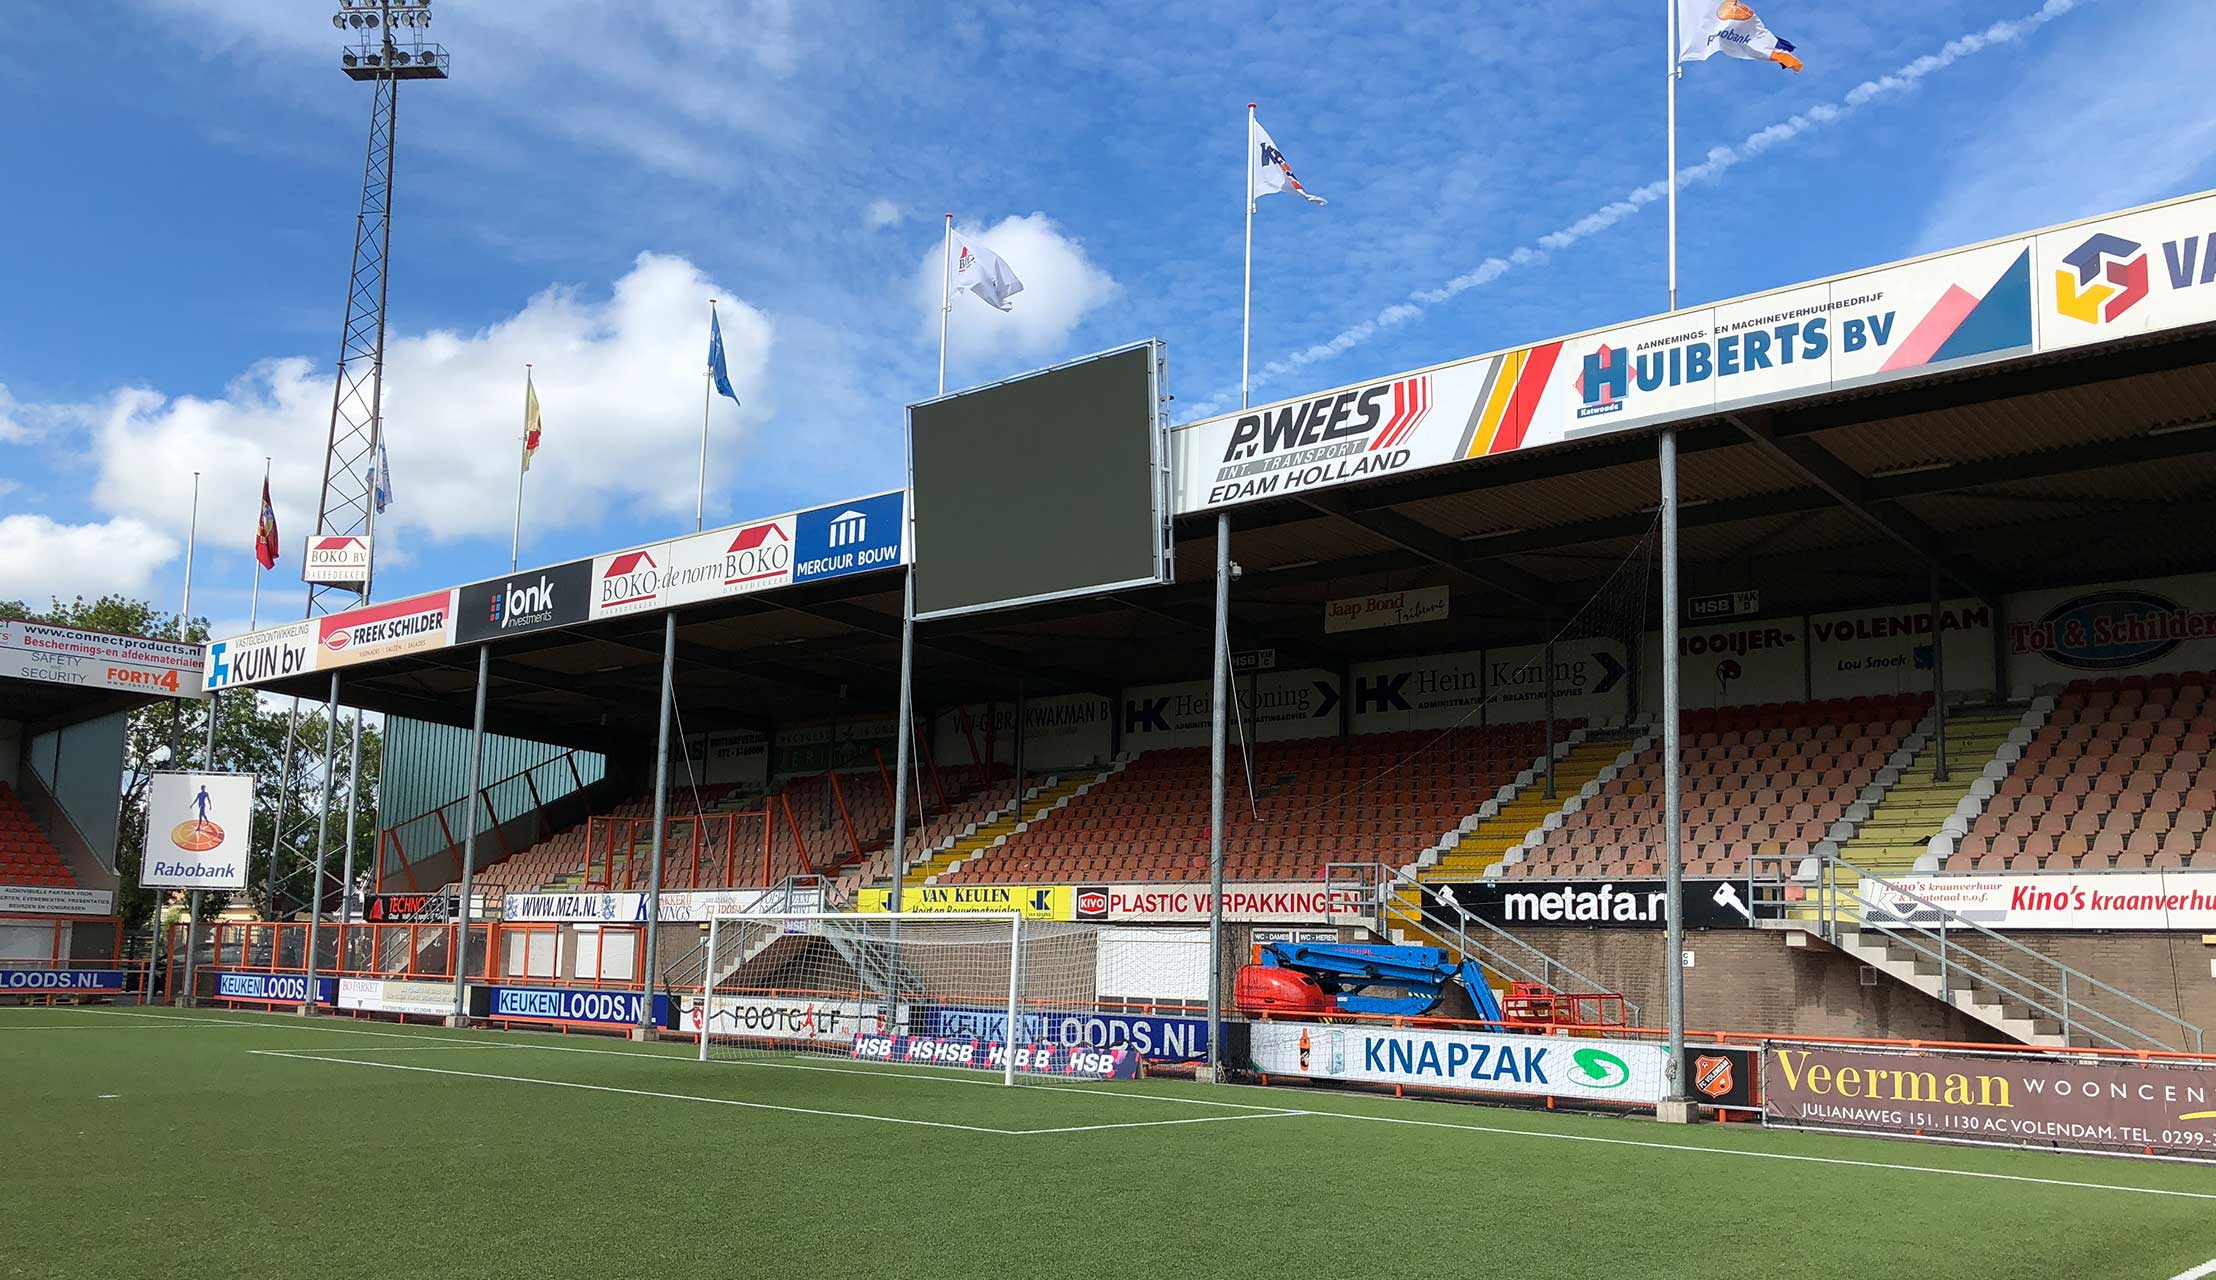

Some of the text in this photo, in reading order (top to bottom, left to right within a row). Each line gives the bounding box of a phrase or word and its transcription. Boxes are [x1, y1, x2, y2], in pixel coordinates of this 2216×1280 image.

[1636, 292, 1884, 351] AANNEMINGS- EN MACHINEVERHUURBEDRIJF
[1583, 311, 1896, 404] HUIBERTS BV
[1580, 403, 1619, 416] Katwoude
[1219, 440, 1361, 480] INT. TRANSPORT
[1208, 450, 1411, 504] EDAM HOLLAND
[311, 550, 348, 562] BOKO
[682, 562, 723, 586] norm
[725, 544, 788, 578] BOKO
[796, 545, 898, 577] MERCUUR BOUW
[501, 575, 554, 628] jonk
[1328, 593, 1404, 619] Jaap Bond
[1694, 599, 1730, 614] HSB
[353, 611, 443, 645] FREEK SCHILDER
[508, 610, 552, 628] investments
[1813, 606, 1990, 642] VOLENDAM
[2007, 608, 2216, 654] Tol & Schilder
[24, 625, 201, 657] www.connectproducts.nl
[235, 623, 309, 648] VASTGOEDONTWIKKELING
[24, 636, 204, 669] Beschermings-en afdekmaterialen
[32, 651, 82, 666] SAFETY
[232, 644, 306, 684] KUIN bv
[1231, 655, 1256, 667] HSB
[1837, 654, 1907, 671] Lou Snoek
[21, 667, 86, 683] SECURITY
[107, 668, 180, 692] FORTY4
[1356, 661, 1587, 714] HK Hein Konng
[1025, 701, 1095, 729] KWAKMAN
[1125, 697, 1172, 733] HK
[1175, 692, 1212, 716] Hei
[153, 861, 236, 878] Rabobank
[922, 887, 1010, 902] VAN KEULEN
[1928, 881, 2003, 892] kraanverhuur
[1963, 893, 1989, 903] v.o.f.
[2011, 886, 2085, 911] Kino's
[521, 895, 597, 917] WWW.MZA.NL
[635, 893, 690, 921] KNINGS
[1080, 898, 1104, 908] KIVO
[1110, 893, 1188, 913] PLASTIC
[1254, 933, 1266, 941] WC
[1269, 933, 1290, 941] DAMES
[1315, 934, 1338, 942] HEREN
[221, 976, 324, 1000] KEUKENLOODS.L
[500, 991, 656, 1023] KEUKENLOODS.N
[857, 1038, 892, 1056] HSB
[1070, 1052, 1115, 1073] HSB
[1364, 1037, 1549, 1084] KNAPZAK
[1773, 1049, 2015, 1108] Veerman
[1801, 1102, 1902, 1124] JULIANAWEG
[1909, 1112, 1939, 1129] 151,
[1945, 1115, 1979, 1130] 1130
[1984, 1118, 2008, 1132] AC
[2011, 1119, 2117, 1141] VOLENDAM.
[2120, 1126, 2157, 1142] TEL.
